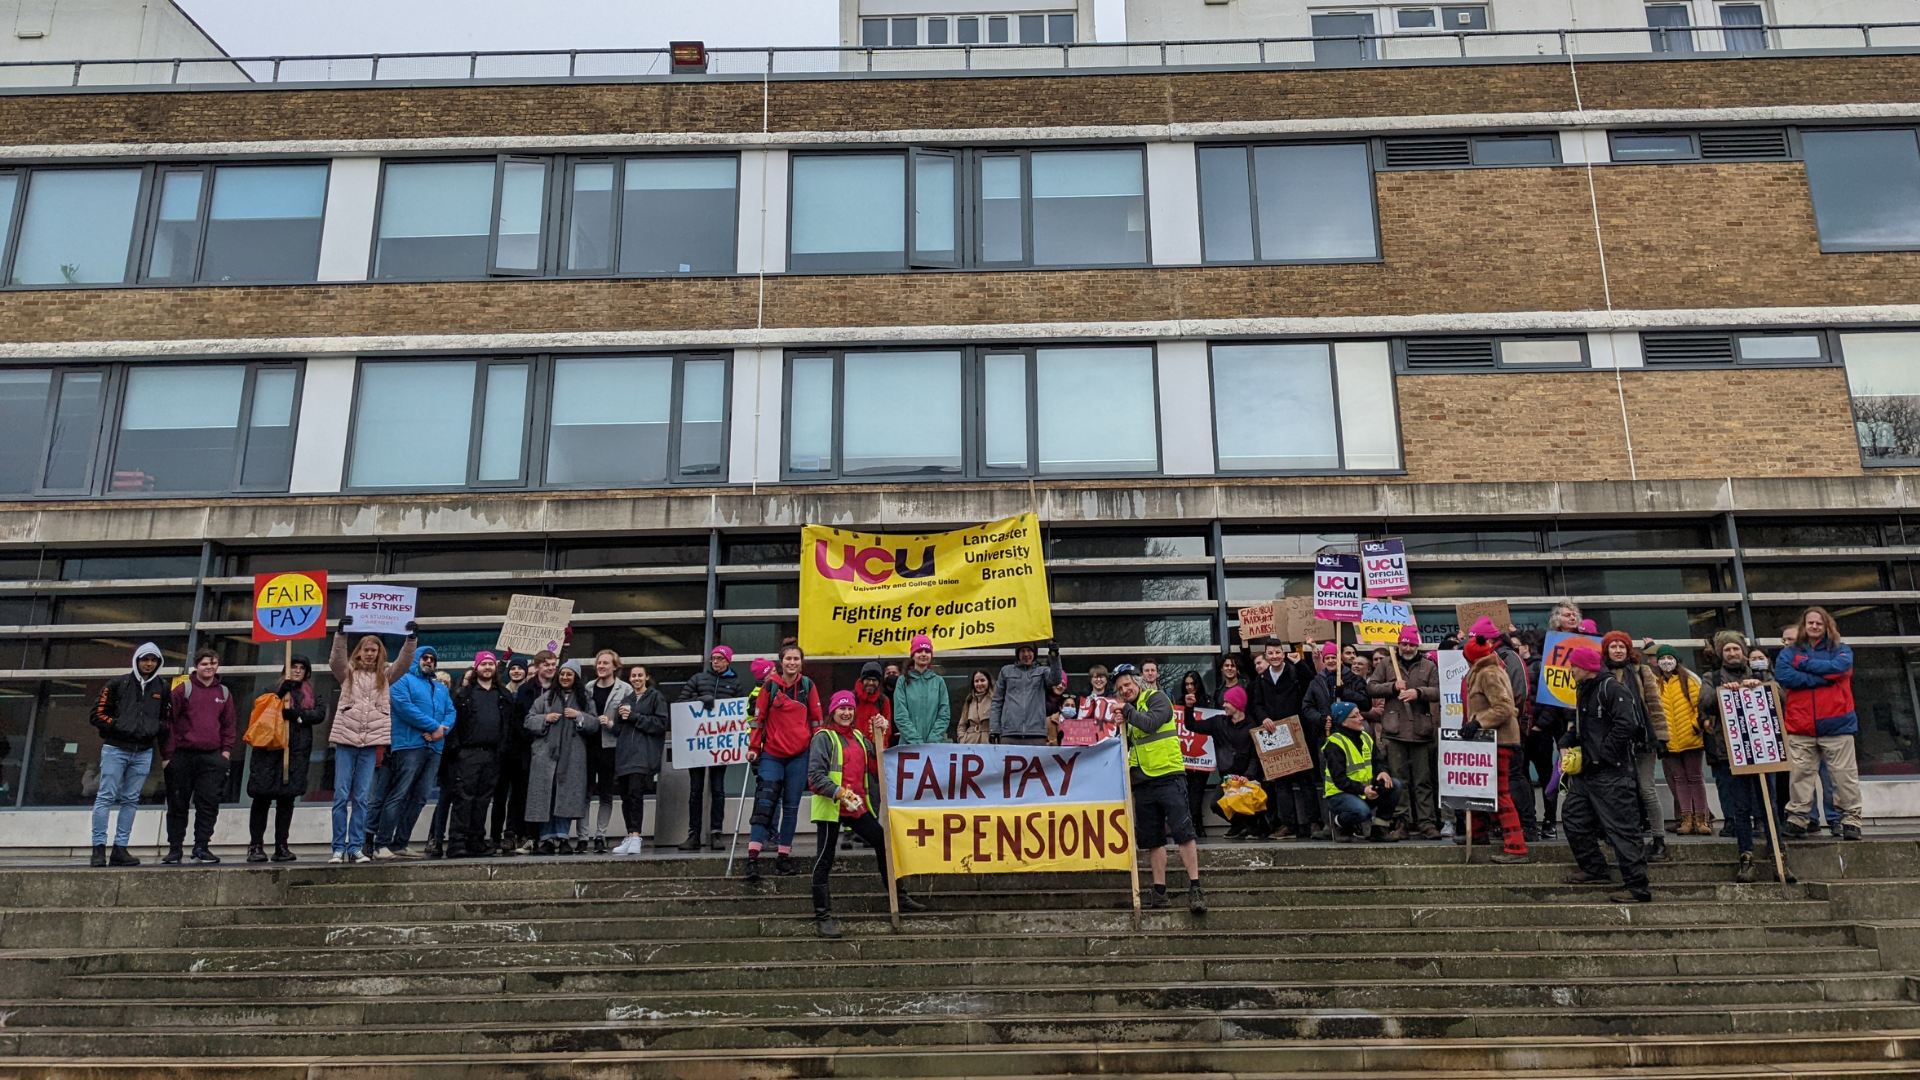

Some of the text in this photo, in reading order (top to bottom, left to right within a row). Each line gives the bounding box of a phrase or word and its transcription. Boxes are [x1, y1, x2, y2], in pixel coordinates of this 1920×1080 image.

[963, 526, 1028, 546] Lancaster
[816, 538, 936, 584] UCU
[964, 545, 1031, 564] University
[981, 563, 1033, 581] Branch
[1367, 558, 1404, 572] UCU
[1368, 570, 1405, 578] OFFICIAL
[1369, 577, 1405, 586] DISPUTE
[853, 584, 890, 592] University
[908, 579, 936, 588] College
[938, 578, 960, 586] Union
[1318, 576, 1358, 590] UCU
[266, 584, 315, 604] FAIR
[359, 592, 405, 602] SUPPORT
[1317, 590, 1358, 598] OFFICIAL
[348, 602, 412, 612] THE STRIKES!
[512, 596, 562, 612] STAFF WORKING
[832, 595, 1017, 624] Fighting for education
[1317, 599, 1358, 608] DISPUTE
[1362, 602, 1407, 618] FAIR
[270, 606, 313, 628] PAY
[508, 609, 550, 624] CONDITIONS
[1240, 609, 1258, 617] CARE
[1362, 618, 1407, 626] ONTRACTS
[1418, 624, 1460, 634] NCASTE
[503, 622, 564, 640] STUDENT LEARNING
[857, 620, 996, 646] Fighting for jobs
[1364, 626, 1400, 636] FOR AL
[499, 636, 546, 651] CONDITIONS
[1546, 668, 1577, 690] PENS
[688, 700, 746, 718] WE ARE
[695, 718, 749, 736] ALWAY
[686, 732, 750, 751] THERE FO
[1738, 716, 1748, 734] Picket
[1744, 740, 1752, 758] Picket
[709, 748, 742, 764] YOU
[1183, 756, 1200, 764] AINST
[1443, 752, 1493, 768] OFFICIAL
[895, 751, 1082, 800] FAIR PAY
[1448, 770, 1489, 786] PICKET
